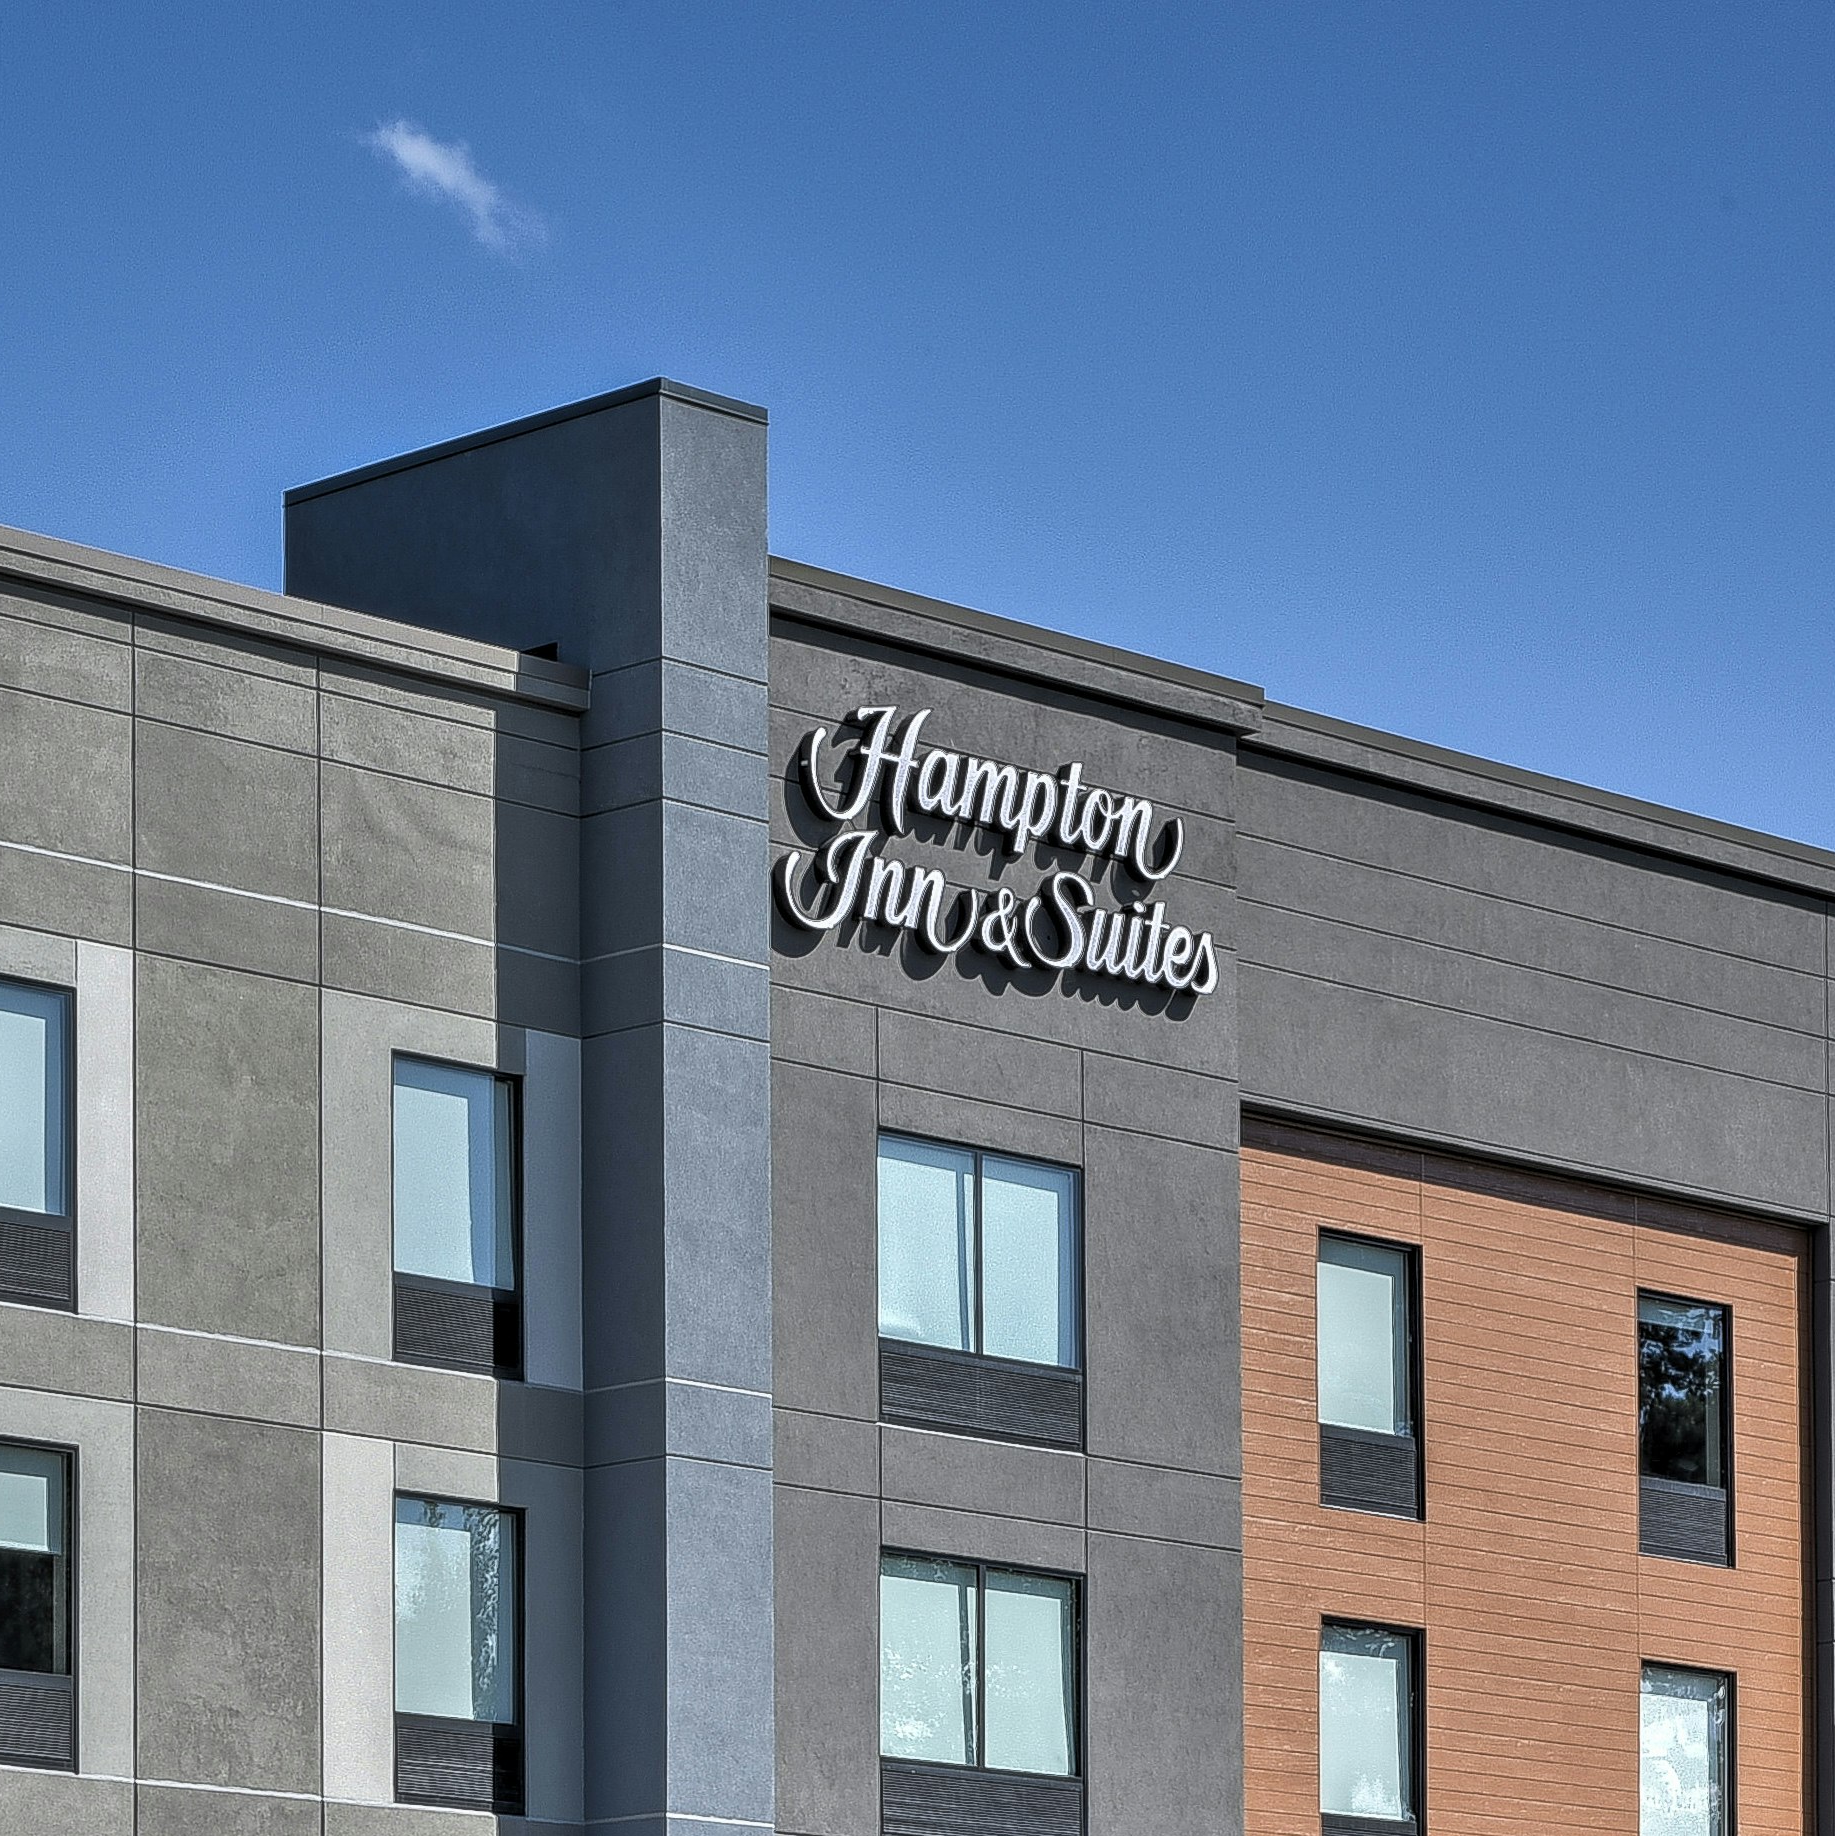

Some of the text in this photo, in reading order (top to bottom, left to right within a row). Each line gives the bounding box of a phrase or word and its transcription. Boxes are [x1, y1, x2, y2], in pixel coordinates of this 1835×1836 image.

[811, 705, 1184, 881] Hampton
[785, 829, 1220, 995] Inn & Suites
